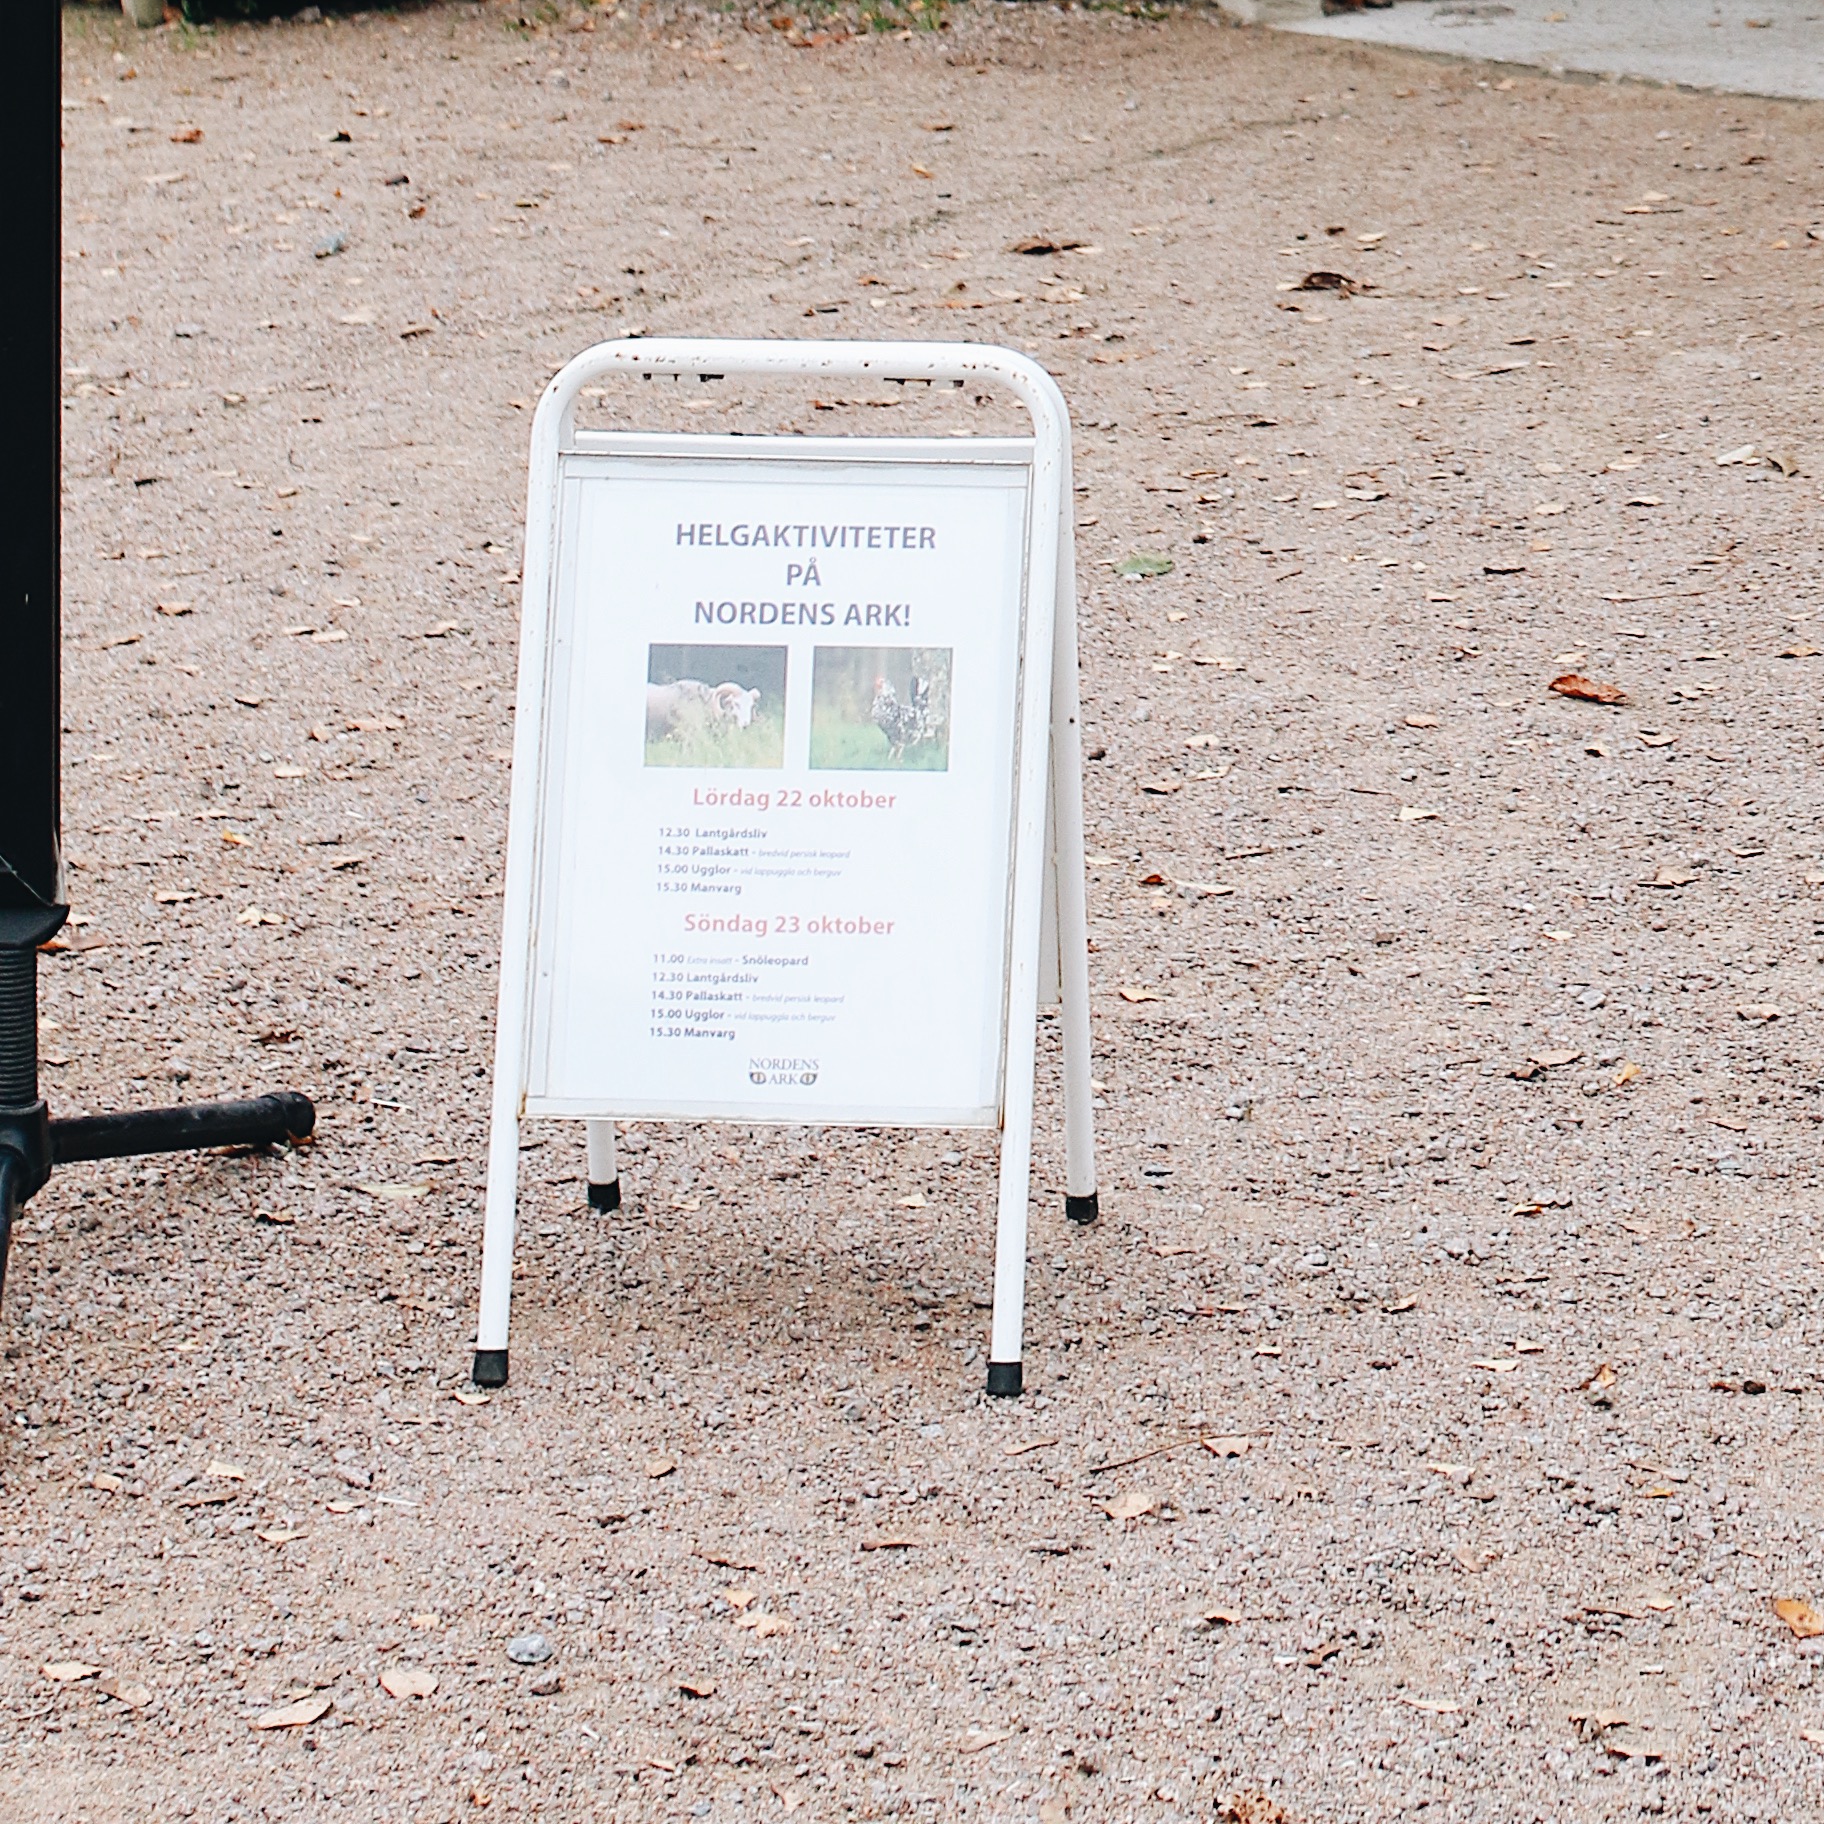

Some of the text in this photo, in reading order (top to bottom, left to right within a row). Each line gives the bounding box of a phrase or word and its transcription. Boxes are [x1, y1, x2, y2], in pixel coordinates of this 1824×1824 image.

[675, 523, 937, 550] HELGAKTIVITETER
[786, 556, 822, 587] PÅ
[694, 600, 911, 628] NORDENS ARK!
[693, 787, 897, 812] Lördag 22 oktober
[658, 827, 768, 841] 12.30 Lantgårdsliv
[657, 845, 689, 856] 14.30
[692, 846, 749, 857] Pallaskatt
[657, 864, 688, 875] 15.00
[691, 864, 731, 877] Ugglor
[656, 882, 742, 896] 15.30 Manvarg
[684, 913, 895, 938] Söndag 23 oktober
[653, 954, 685, 964] 11.00
[741, 955, 809, 968] Snöleopard
[653, 972, 759, 985] 12.30 Lantgårdsliv
[651, 990, 683, 1001] 14.30
[685, 991, 743, 1001] Pallaskatt
[650, 1008, 682, 1019] 15.00
[685, 1008, 725, 1022] Ugglor
[650, 1027, 736, 1041] 15.30 Manvarg
[749, 1057, 820, 1071] NORDENS
[768, 1072, 798, 1086] ARK
